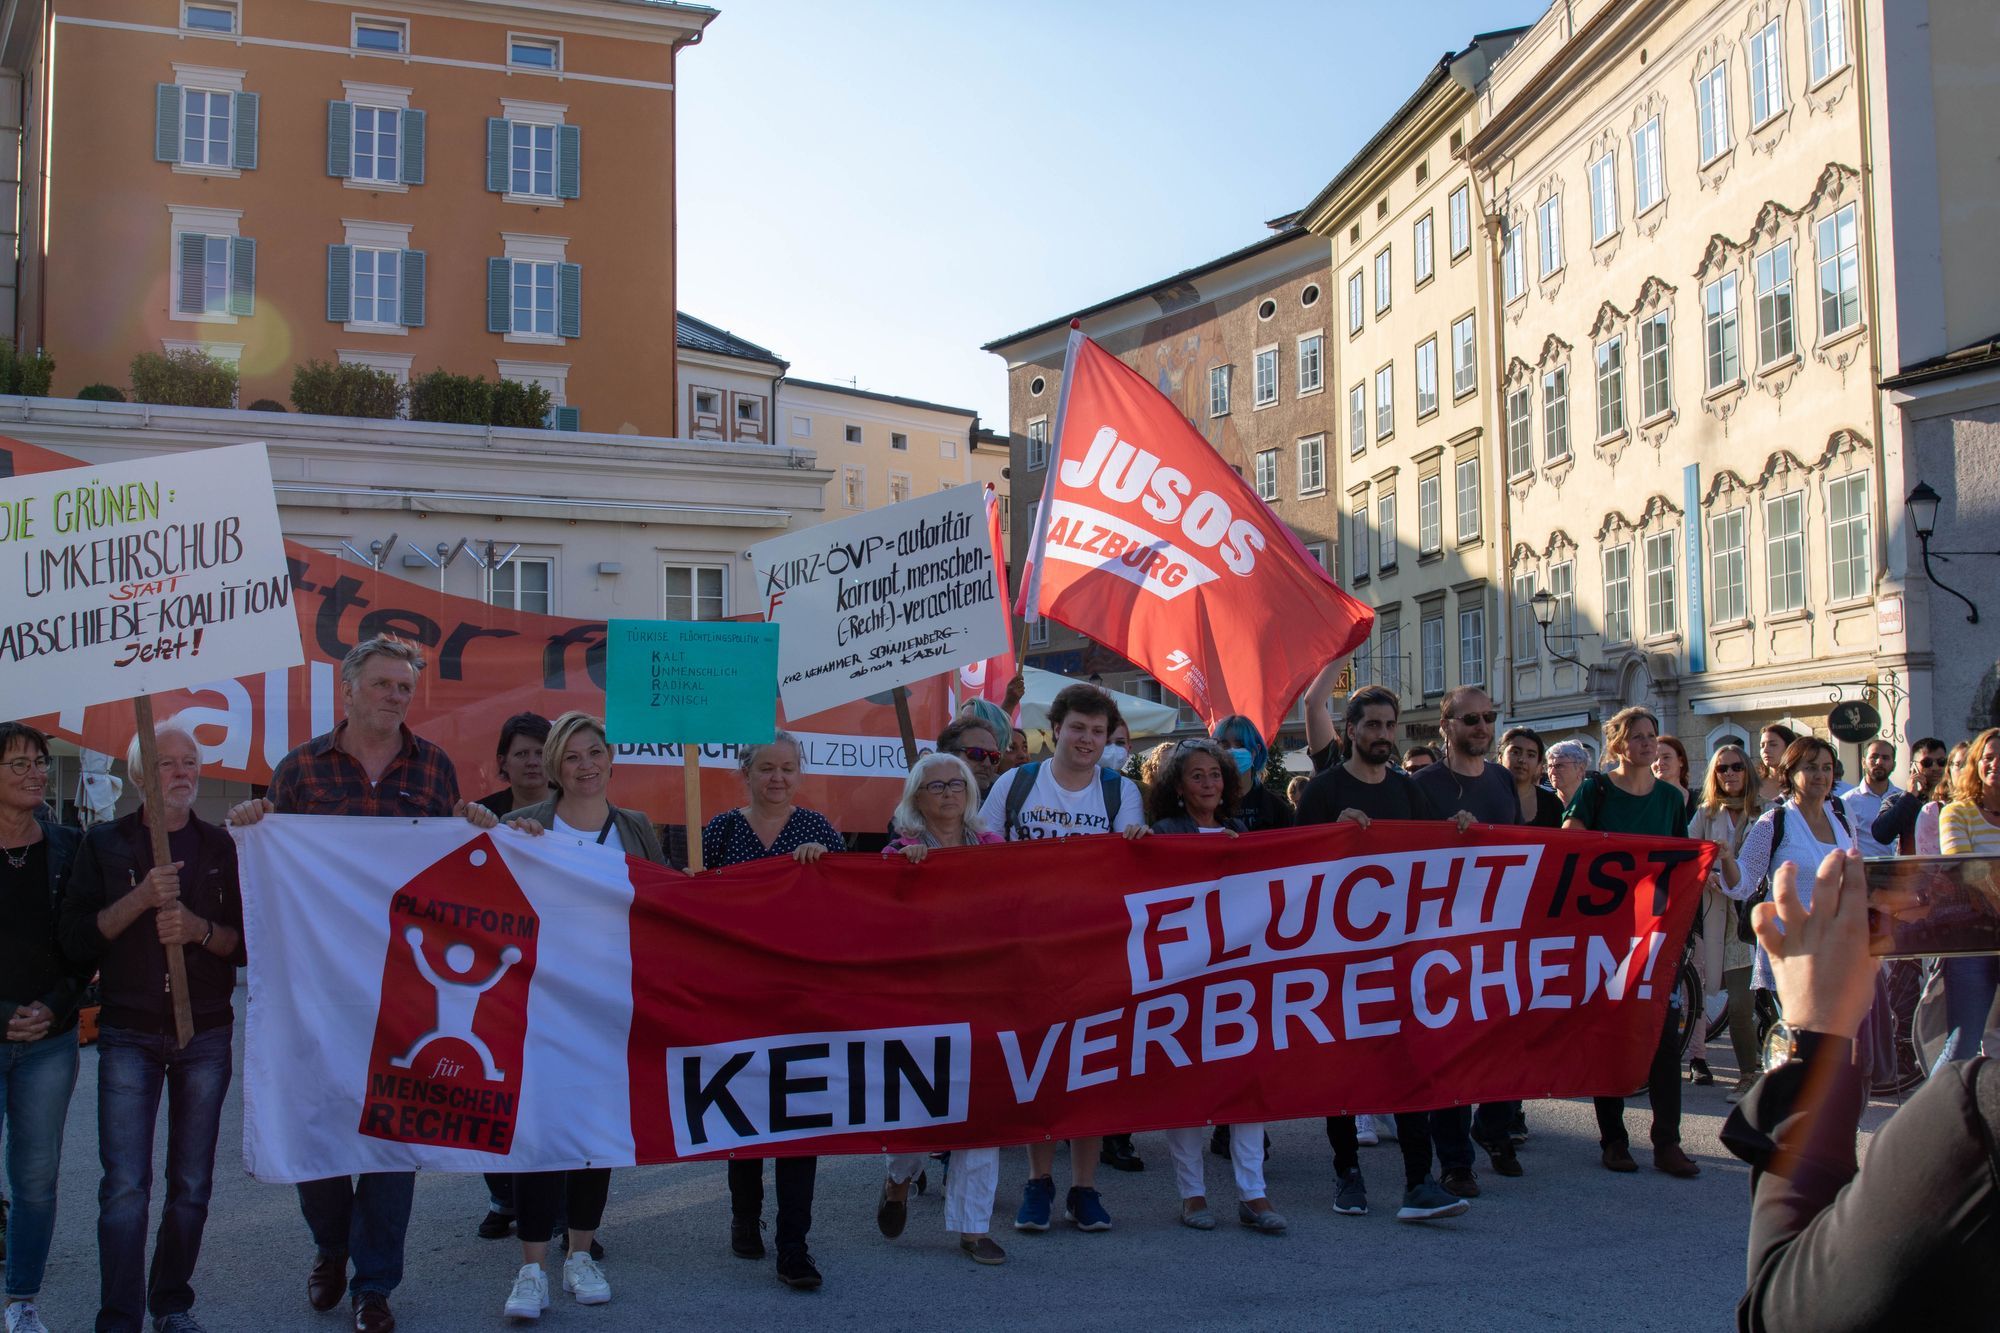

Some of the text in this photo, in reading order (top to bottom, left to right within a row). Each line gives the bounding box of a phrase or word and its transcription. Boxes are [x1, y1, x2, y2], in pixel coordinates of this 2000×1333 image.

[1059, 425, 1266, 578] JUSOS
[0, 497, 36, 542] DIE
[897, 511, 973, 556] autoritär
[25, 516, 243, 597] UMKEHRSCHUB
[1046, 514, 1189, 588] ALZBURG
[109, 574, 190, 600] STATT
[836, 547, 992, 613] korrupt, menschen-
[767, 592, 786, 621] F
[627, 627, 669, 643] TÜRKISE
[652, 650, 685, 663] KALT
[804, 653, 862, 680] NEHAMMER
[900, 643, 957, 665] KABUL
[651, 665, 738, 677] UNMENSCHLICH
[651, 679, 704, 691] RADIKAL
[651, 694, 708, 706] ZYNISCH
[799, 740, 910, 769] ALZBURG
[1075, 813, 1109, 831] EXPL
[395, 893, 535, 940] PLATTFORM
[1143, 849, 1700, 982] FLUCHT IST
[682, 931, 1667, 1146] KEIN VERBRECHEN!
[428, 1056, 464, 1080] für
[370, 1073, 513, 1116] MENSCHEN
[365, 1102, 511, 1149] RECHTE
